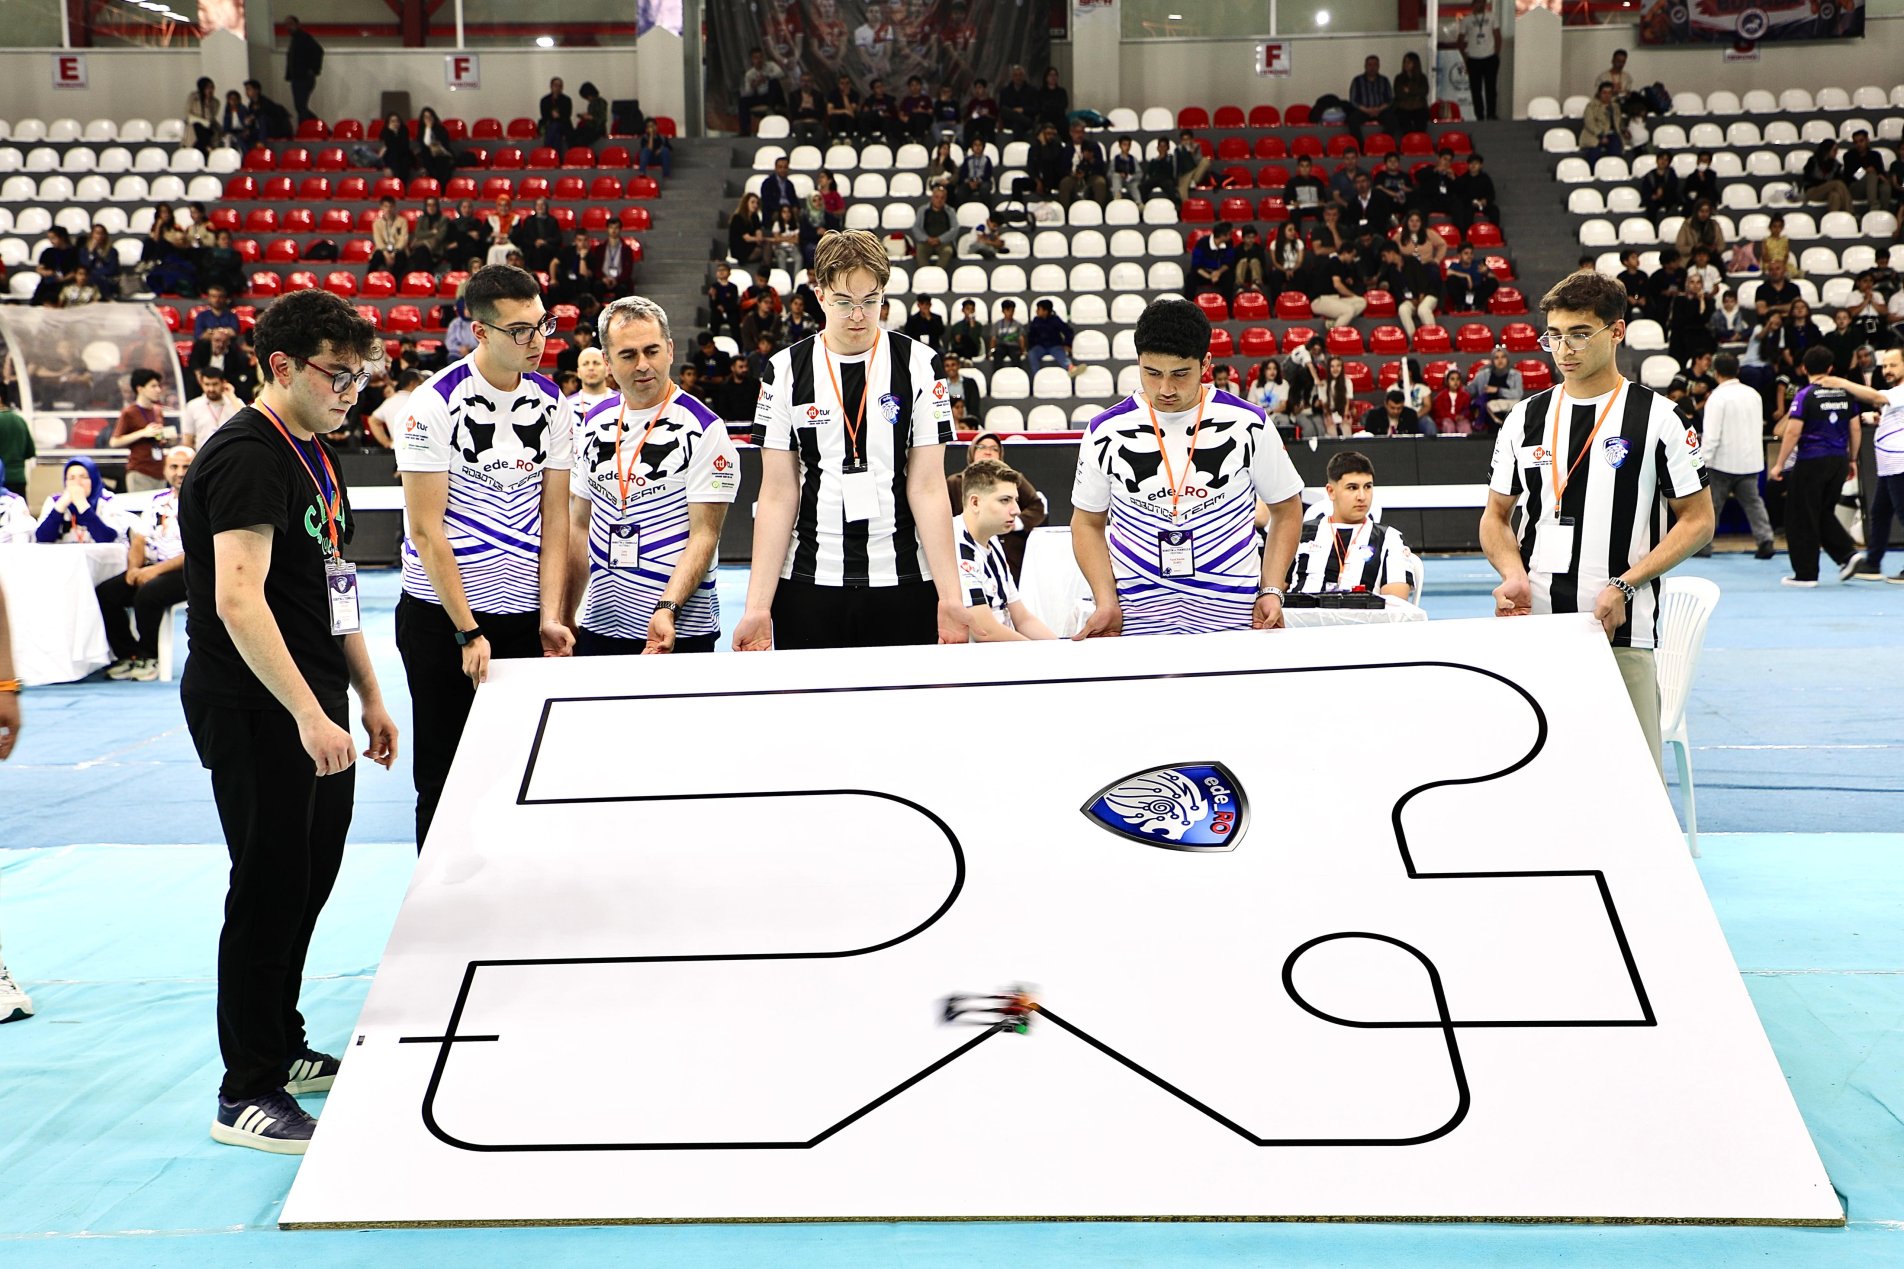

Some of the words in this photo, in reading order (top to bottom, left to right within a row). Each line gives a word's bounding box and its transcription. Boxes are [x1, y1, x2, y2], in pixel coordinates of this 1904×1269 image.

[1266, 45, 1282, 68] F
[59, 57, 79, 80] E
[454, 57, 470, 80] F
[416, 421, 428, 431] tur
[483, 459, 534, 472] ede_RO
[726, 461, 734, 469] tu
[1180, 492, 1225, 520] TEAM
[1204, 776, 1235, 835] ede_RO
